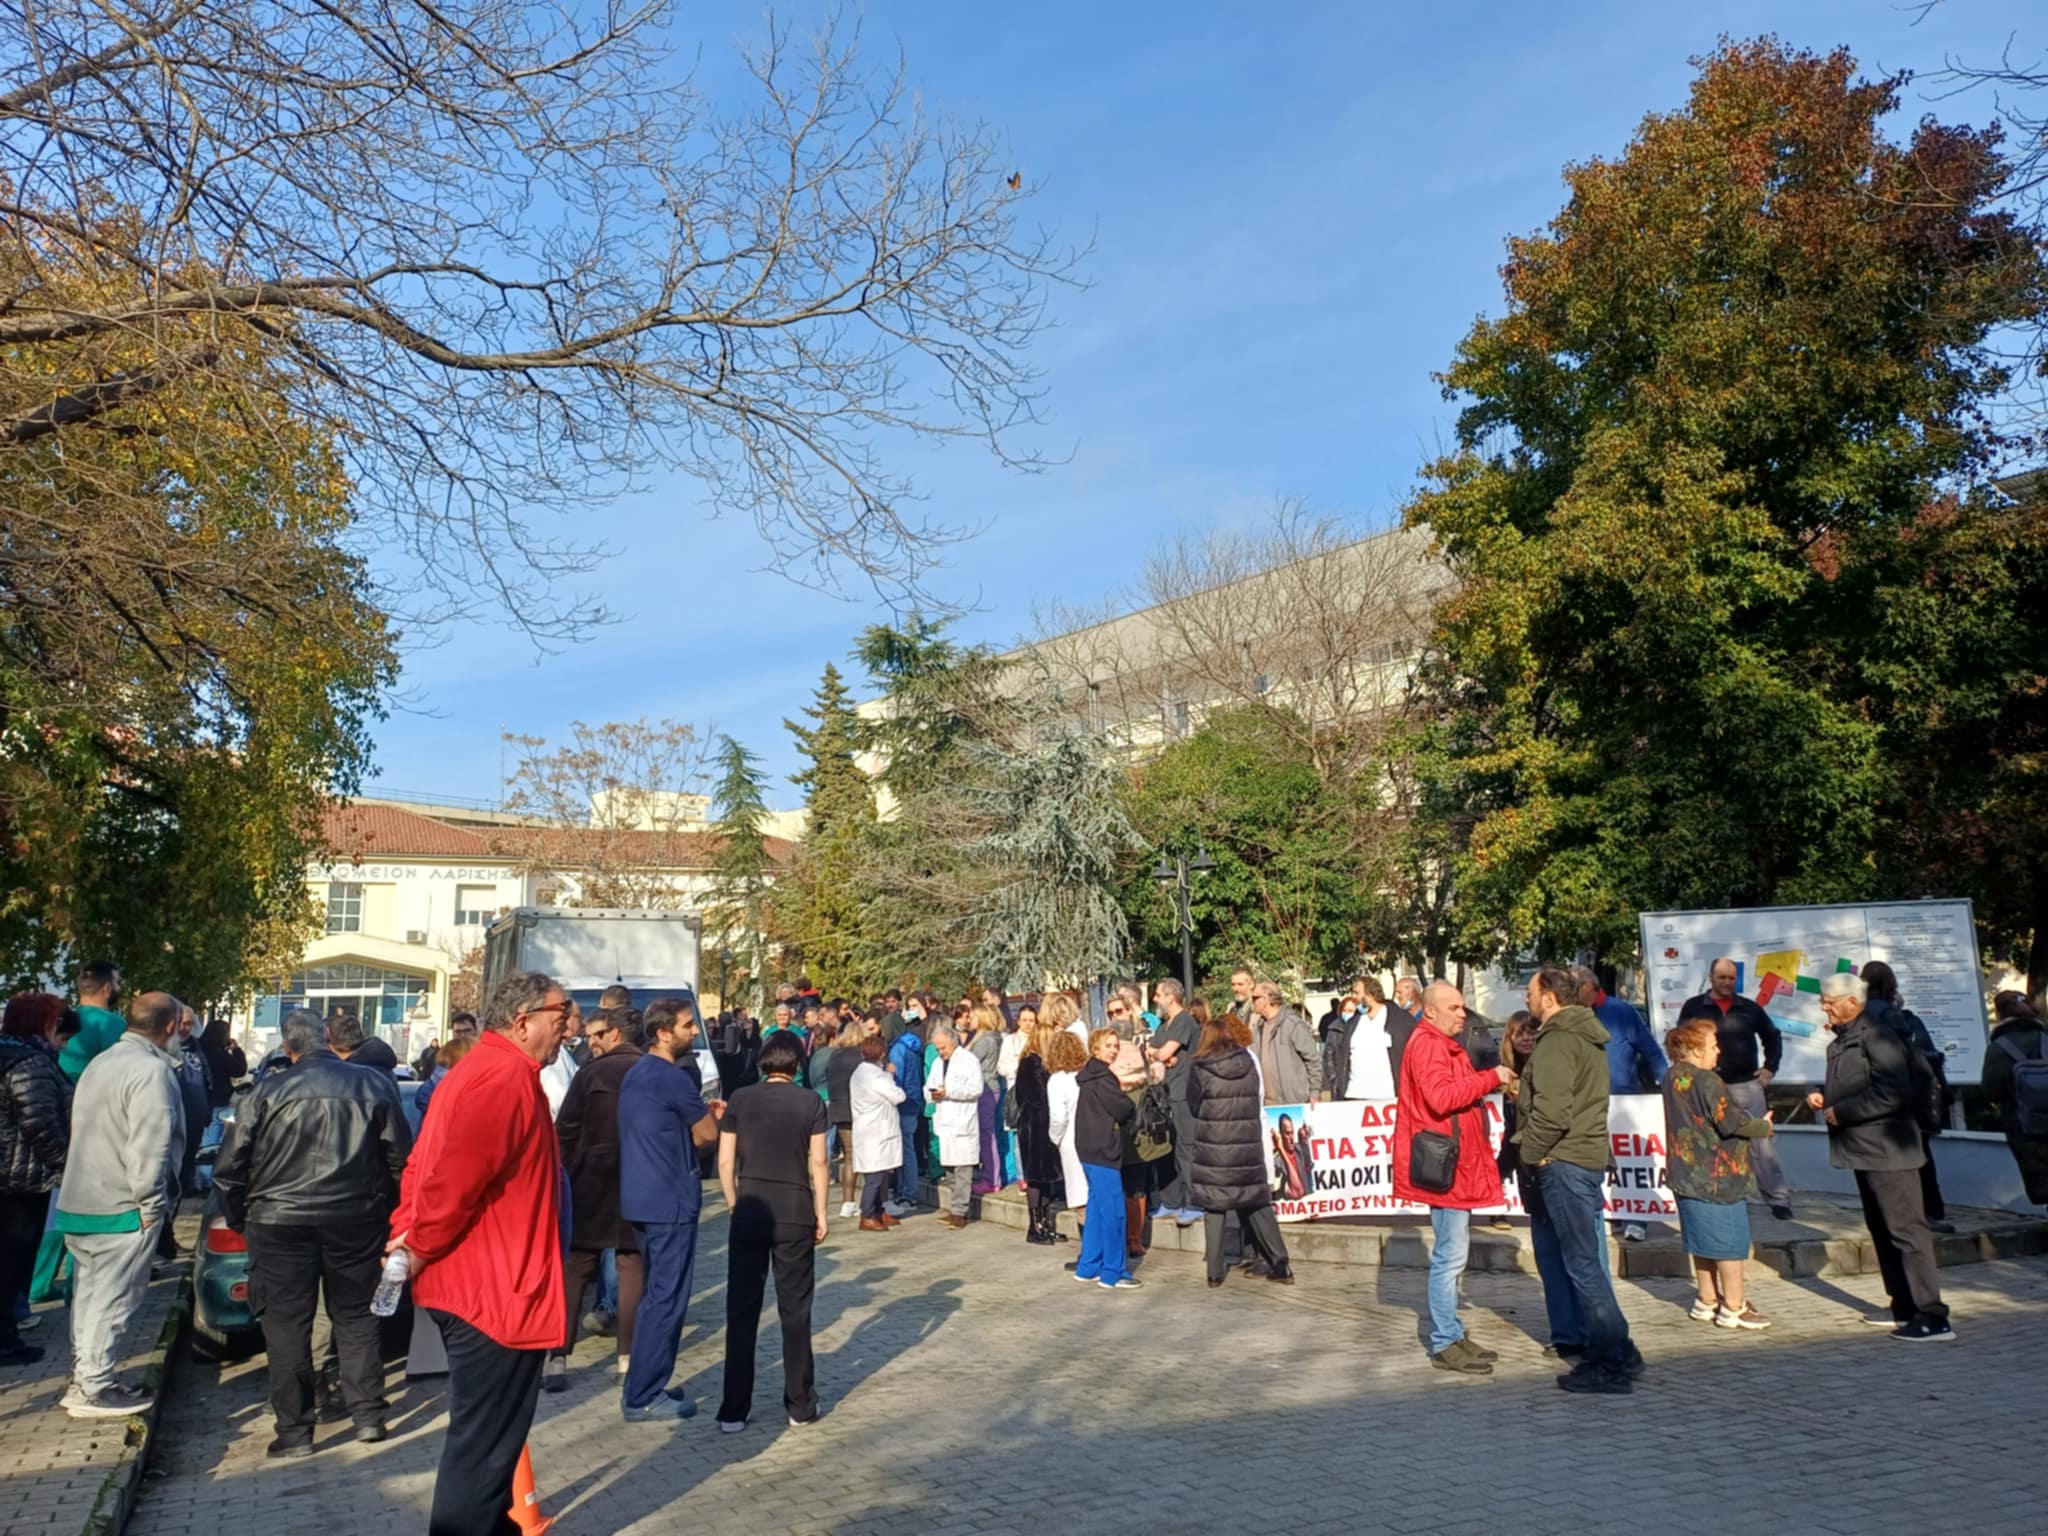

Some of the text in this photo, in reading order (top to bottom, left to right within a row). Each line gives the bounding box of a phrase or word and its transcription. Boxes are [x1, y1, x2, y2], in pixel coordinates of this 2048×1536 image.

[1361, 1104, 1398, 1127] ΔΩ
[1310, 1133, 1667, 1161] ΓΙΑ ΣΥ ΕΙΑ
[1314, 1168, 1346, 1191] ΚΑΙ
[1351, 1164, 1380, 1187] ΟΧΙ
[1607, 1167, 1669, 1189] ΑΓΕΙΑ
[1270, 1194, 1676, 1216] ΩΜΑΤΕΙΟ ΣΥΝΤΑ ΑΡΙΣΑΣ
